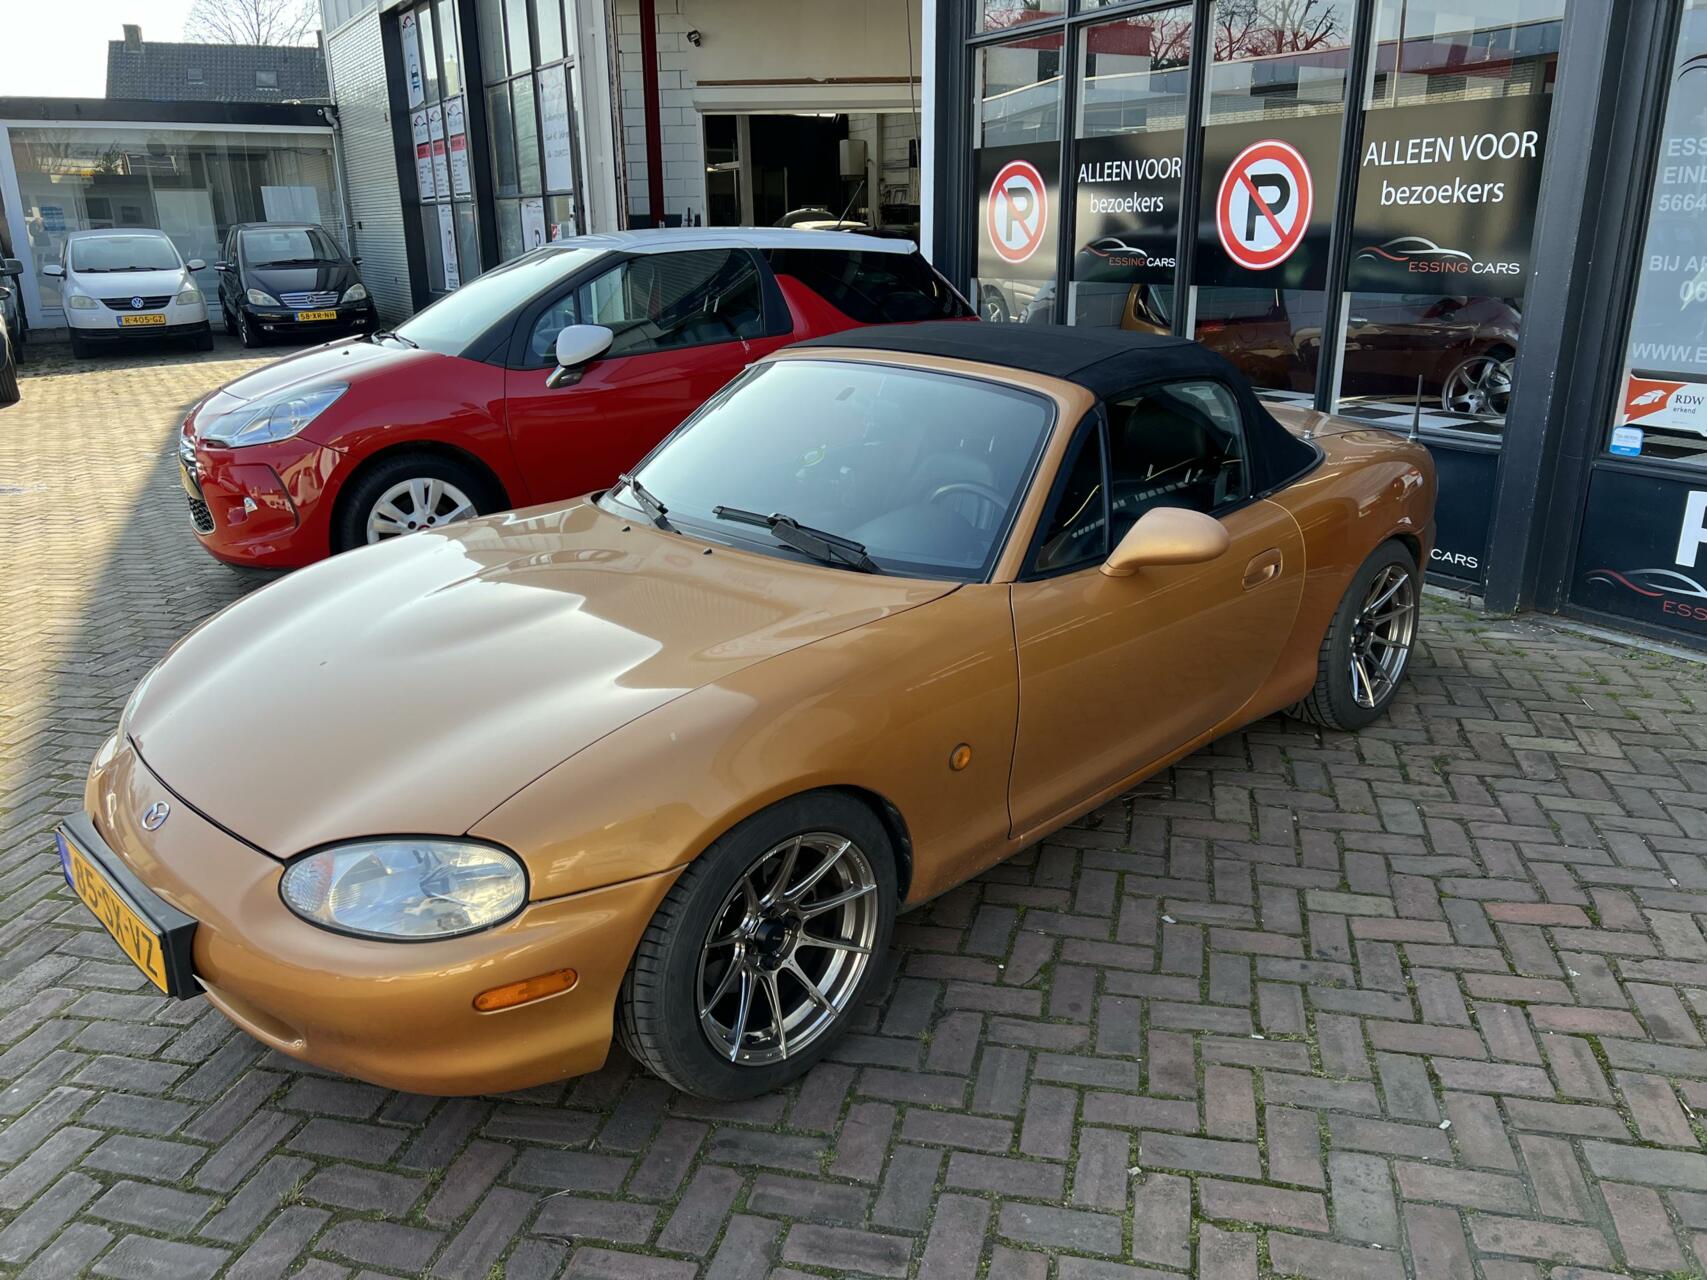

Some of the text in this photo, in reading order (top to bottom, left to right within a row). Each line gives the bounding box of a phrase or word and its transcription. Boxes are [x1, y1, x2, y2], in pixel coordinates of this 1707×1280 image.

[1363, 130, 1538, 167] ALLEEN VOOR
[1078, 157, 1182, 183] ALLEEN VOOR
[1380, 176, 1505, 206] bezoekers
[1090, 191, 1164, 214] bezoekers
[1658, 192, 1707, 212] 5664
[1109, 256, 1176, 268] ESSING CARS
[1408, 260, 1521, 275] ESSING CARS
[1648, 254, 1681, 272] BIJ
[124, 315, 164, 324] R-405-GZ
[1675, 394, 1705, 406] RDW
[1673, 406, 1696, 415] erkend
[1430, 548, 1479, 569] CARS
